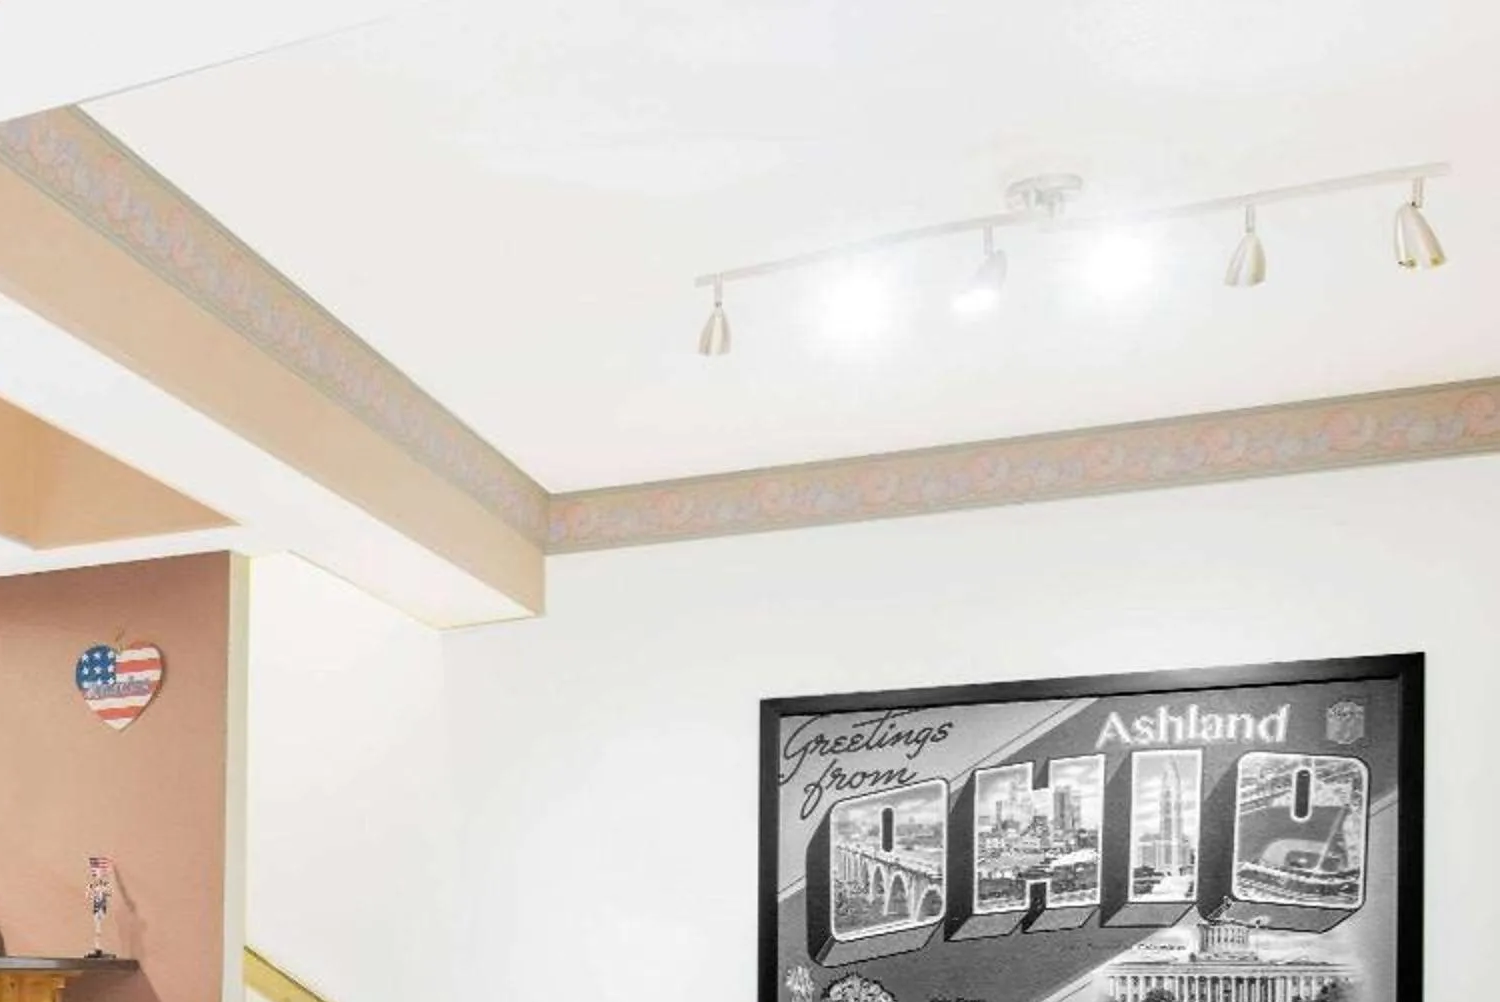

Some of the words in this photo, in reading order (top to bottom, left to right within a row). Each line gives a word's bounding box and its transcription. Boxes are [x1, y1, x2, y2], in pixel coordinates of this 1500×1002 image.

[779, 708, 953, 786] Greetings
[1095, 703, 1291, 748] Ashland
[801, 758, 918, 820] from
[807, 748, 1369, 967] OHIO
